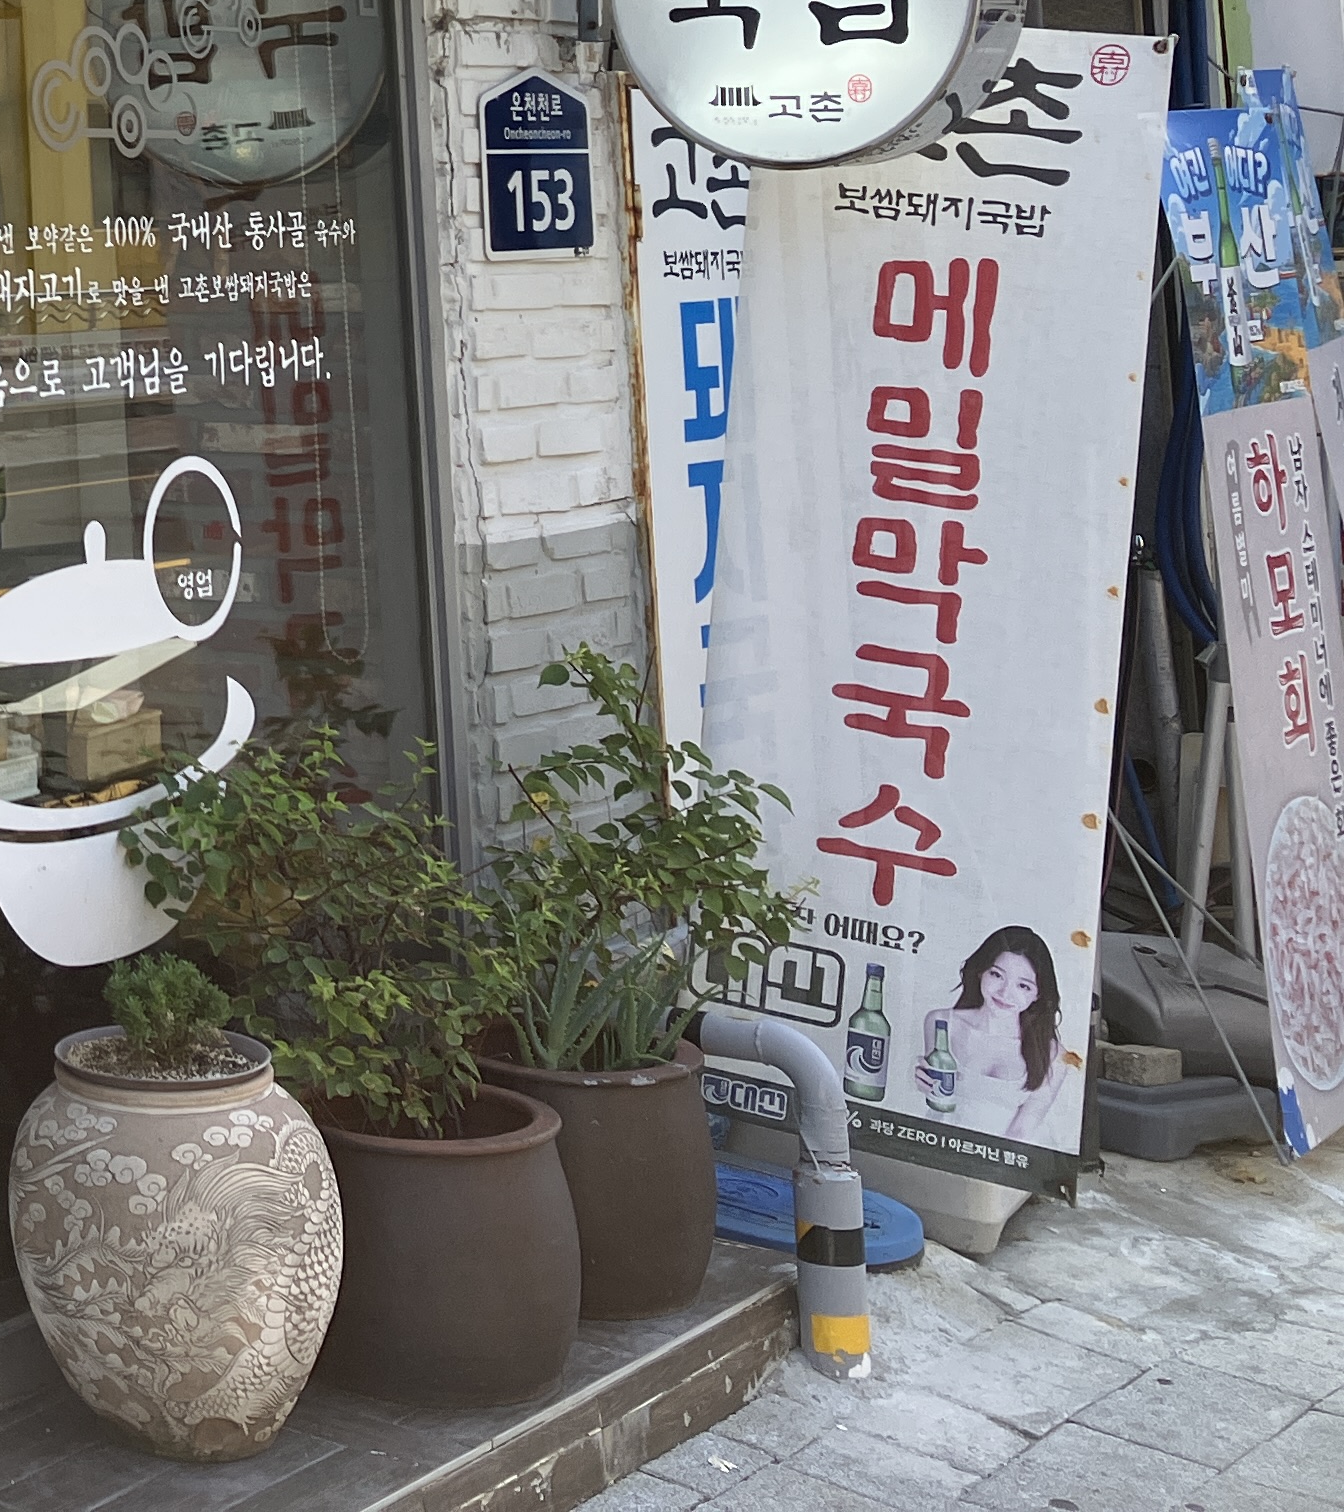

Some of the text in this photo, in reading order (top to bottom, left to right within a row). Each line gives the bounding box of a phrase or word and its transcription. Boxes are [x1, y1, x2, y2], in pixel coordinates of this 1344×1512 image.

[510, 91, 563, 122] 온천천로
[767, 90, 845, 124] 고촌
[504, 126, 572, 141] Oncheoncheon-ro
[507, 168, 576, 232] 153
[834, 182, 1053, 239] 보쌈돼지국밥
[25, 221, 95, 255] 보약같은
[102, 215, 157, 248] 100%
[168, 210, 233, 251] 국내산
[244, 210, 307, 251] 통사골
[662, 248, 747, 281] 보쌈돼지국
[112, 276, 145, 307] 맛을
[82, 347, 188, 400] 고객님을
[204, 335, 332, 389] 기다립니다.
[1246, 430, 1317, 759] 하모회
[823, 912, 927, 955] 어때요?
[869, 1118, 894, 1137] 과당
[896, 1125, 938, 1146] ZERO
[948, 1137, 1000, 1163] 아르지닌
